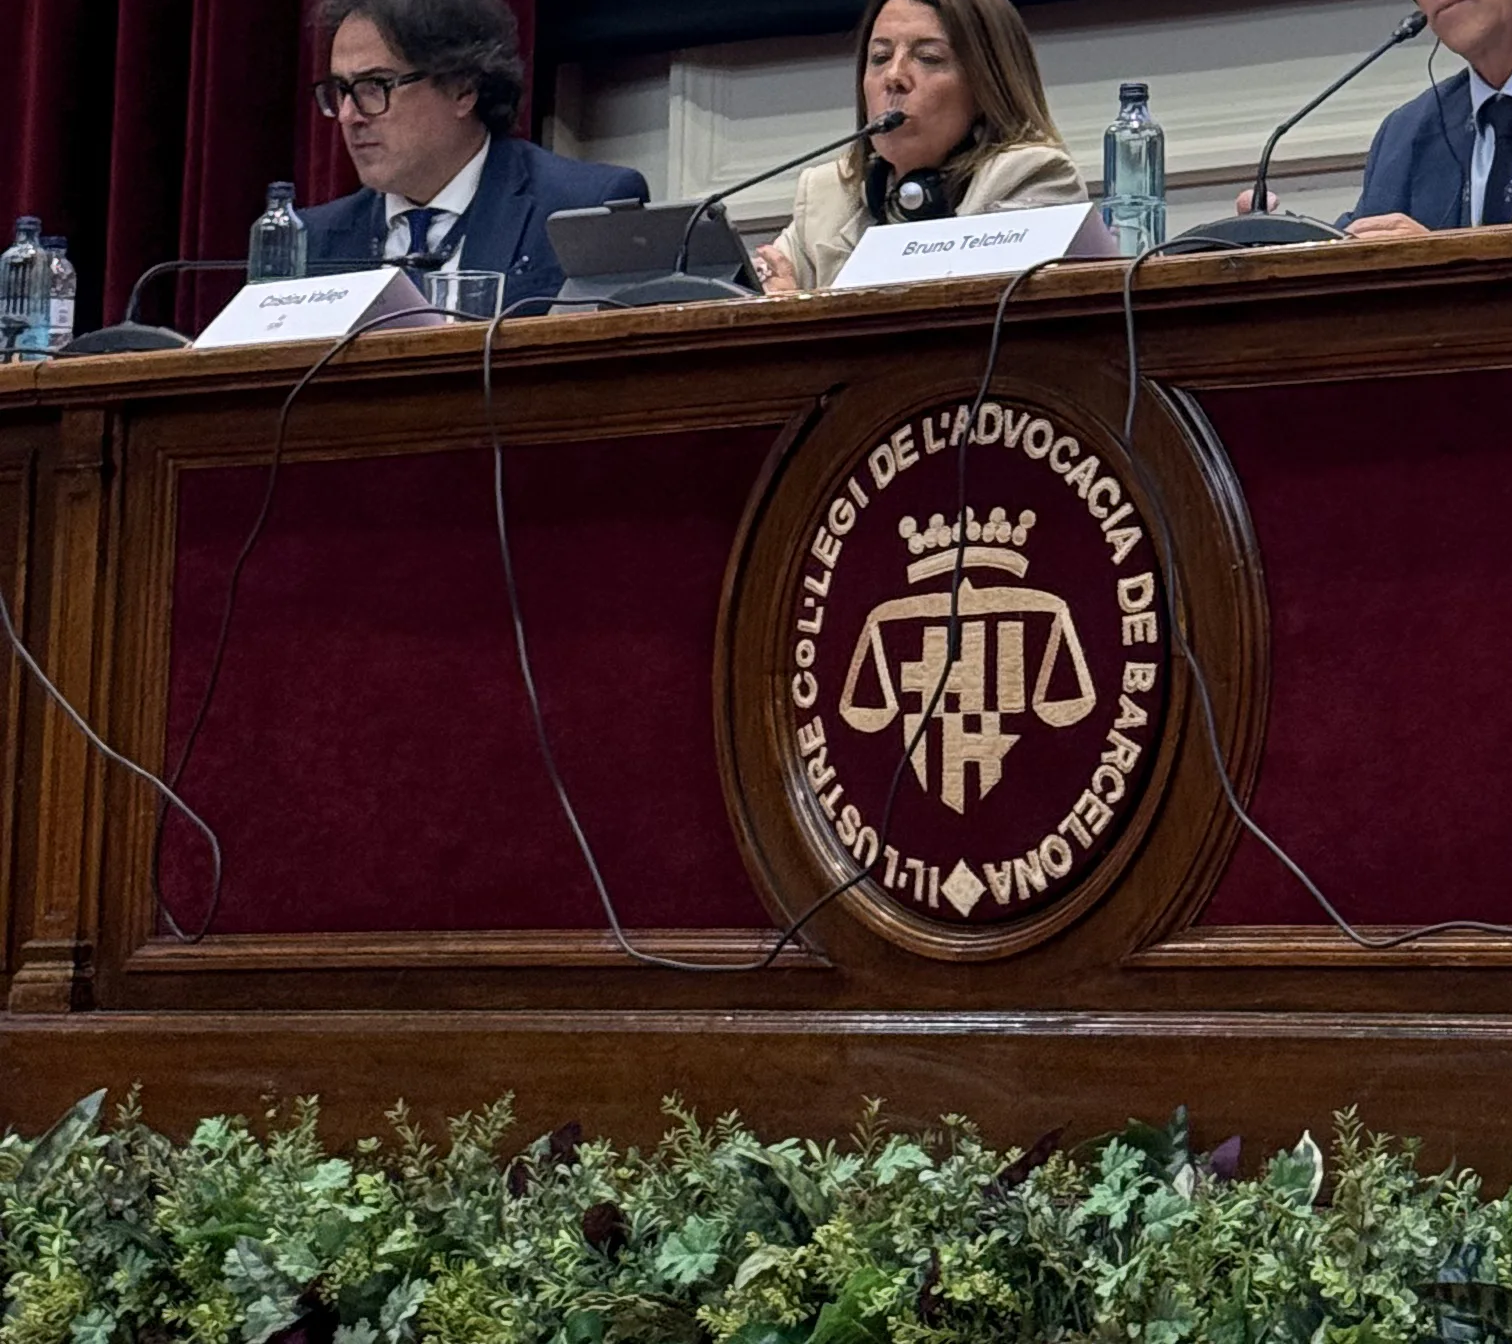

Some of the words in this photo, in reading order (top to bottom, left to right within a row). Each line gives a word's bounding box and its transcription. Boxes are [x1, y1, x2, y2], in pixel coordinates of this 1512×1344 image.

[901, 240, 955, 257] Bruno
[959, 228, 1029, 250] Telchini
[867, 422, 920, 491] DE
[1116, 571, 1158, 647] DE
[982, 661, 1158, 905] BARCELONA
